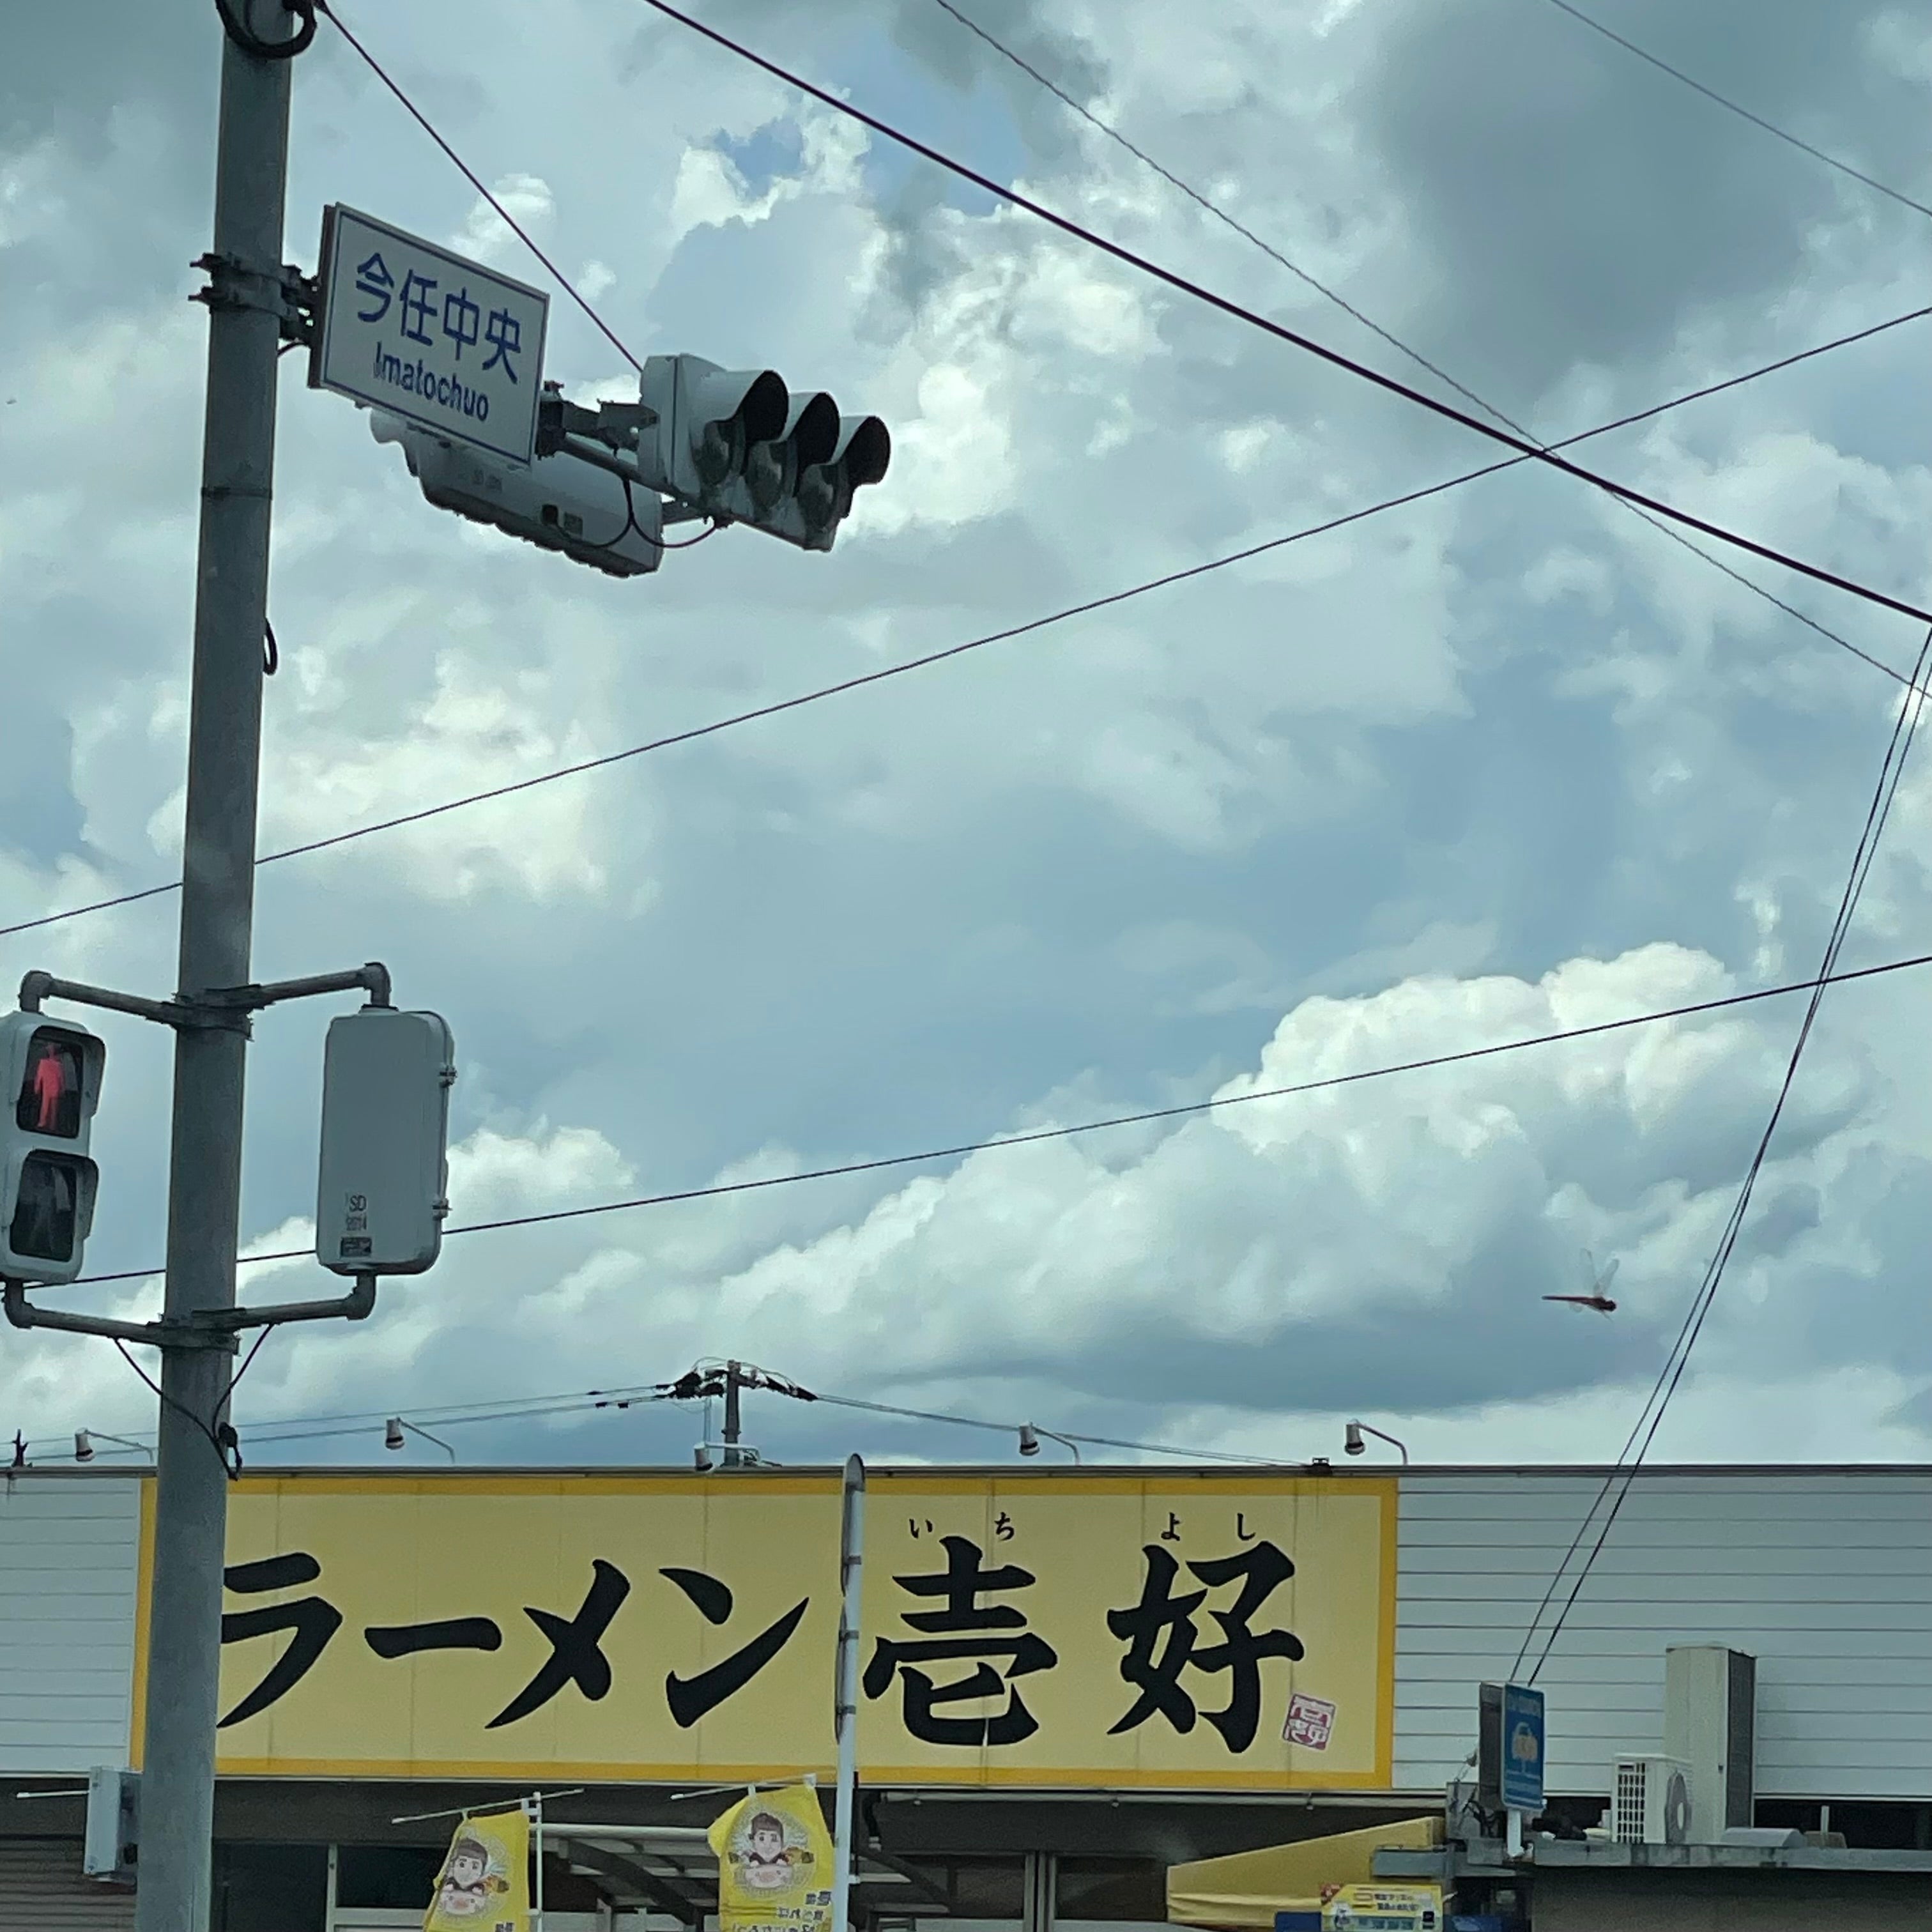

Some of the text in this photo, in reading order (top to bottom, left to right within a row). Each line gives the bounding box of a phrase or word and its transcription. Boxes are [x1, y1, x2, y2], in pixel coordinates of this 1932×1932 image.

[355, 252, 521, 385] 今任中央
[372, 340, 489, 422] Imatochuo
